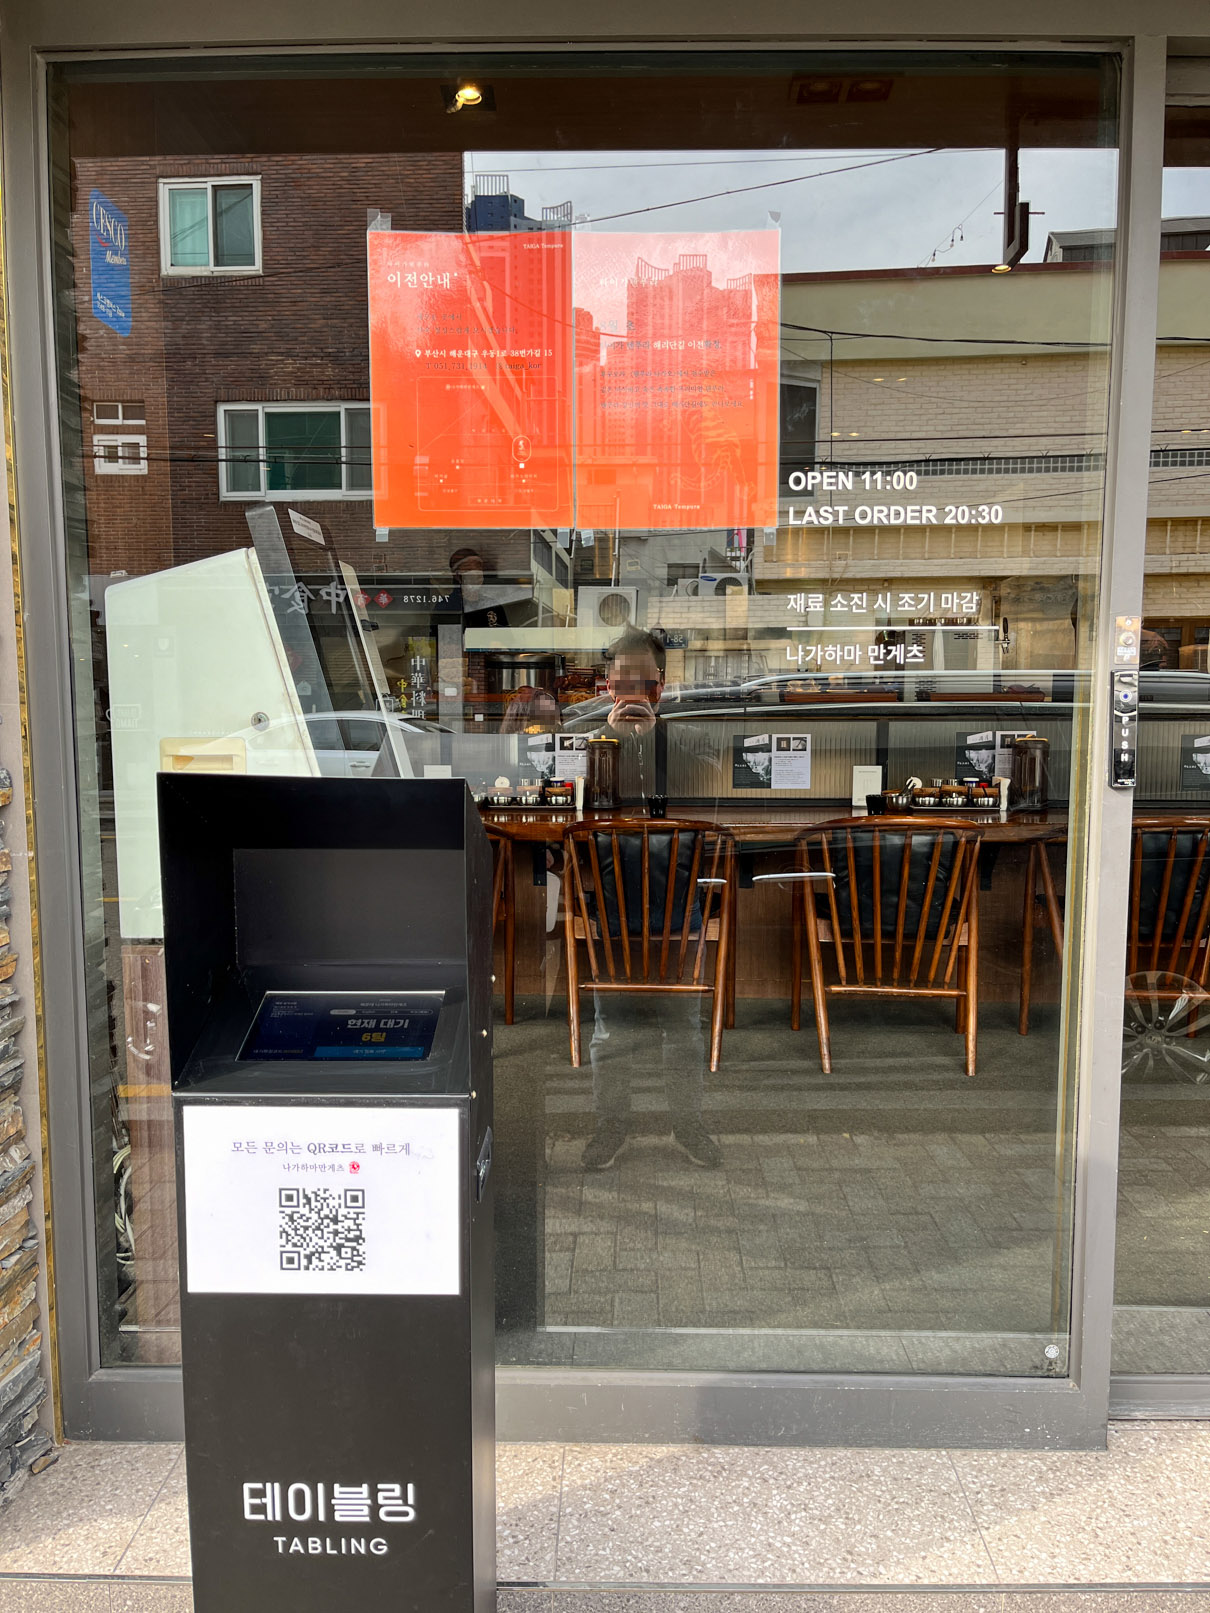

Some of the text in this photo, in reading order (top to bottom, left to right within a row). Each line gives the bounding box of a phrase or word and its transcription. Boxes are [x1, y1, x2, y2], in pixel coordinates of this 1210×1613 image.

[93, 201, 125, 251] CESCO
[387, 271, 451, 289] 이전안내
[424, 349, 447, 359] 부산시
[449, 349, 479, 359] 해운대구
[510, 349, 541, 358] 38번가길
[544, 349, 553, 357] 15
[653, 340, 685, 351] 해리단길
[788, 471, 918, 491] OPEN 11:00
[789, 505, 1003, 525] LAST ORDER 20:30
[786, 591, 979, 613] 재료 소진 시 조기 마감
[786, 644, 925, 665] 나가하마 만게츠
[1121, 716, 1130, 762] PUSH
[347, 1019, 410, 1029] 현재 대기
[231, 1141, 411, 1156] 모든 문의는 QR코드로 빠르게
[282, 1163, 345, 1173] 나가하마만게츠
[243, 1482, 416, 1522] 테이블링
[273, 1537, 389, 1555] TABLING
